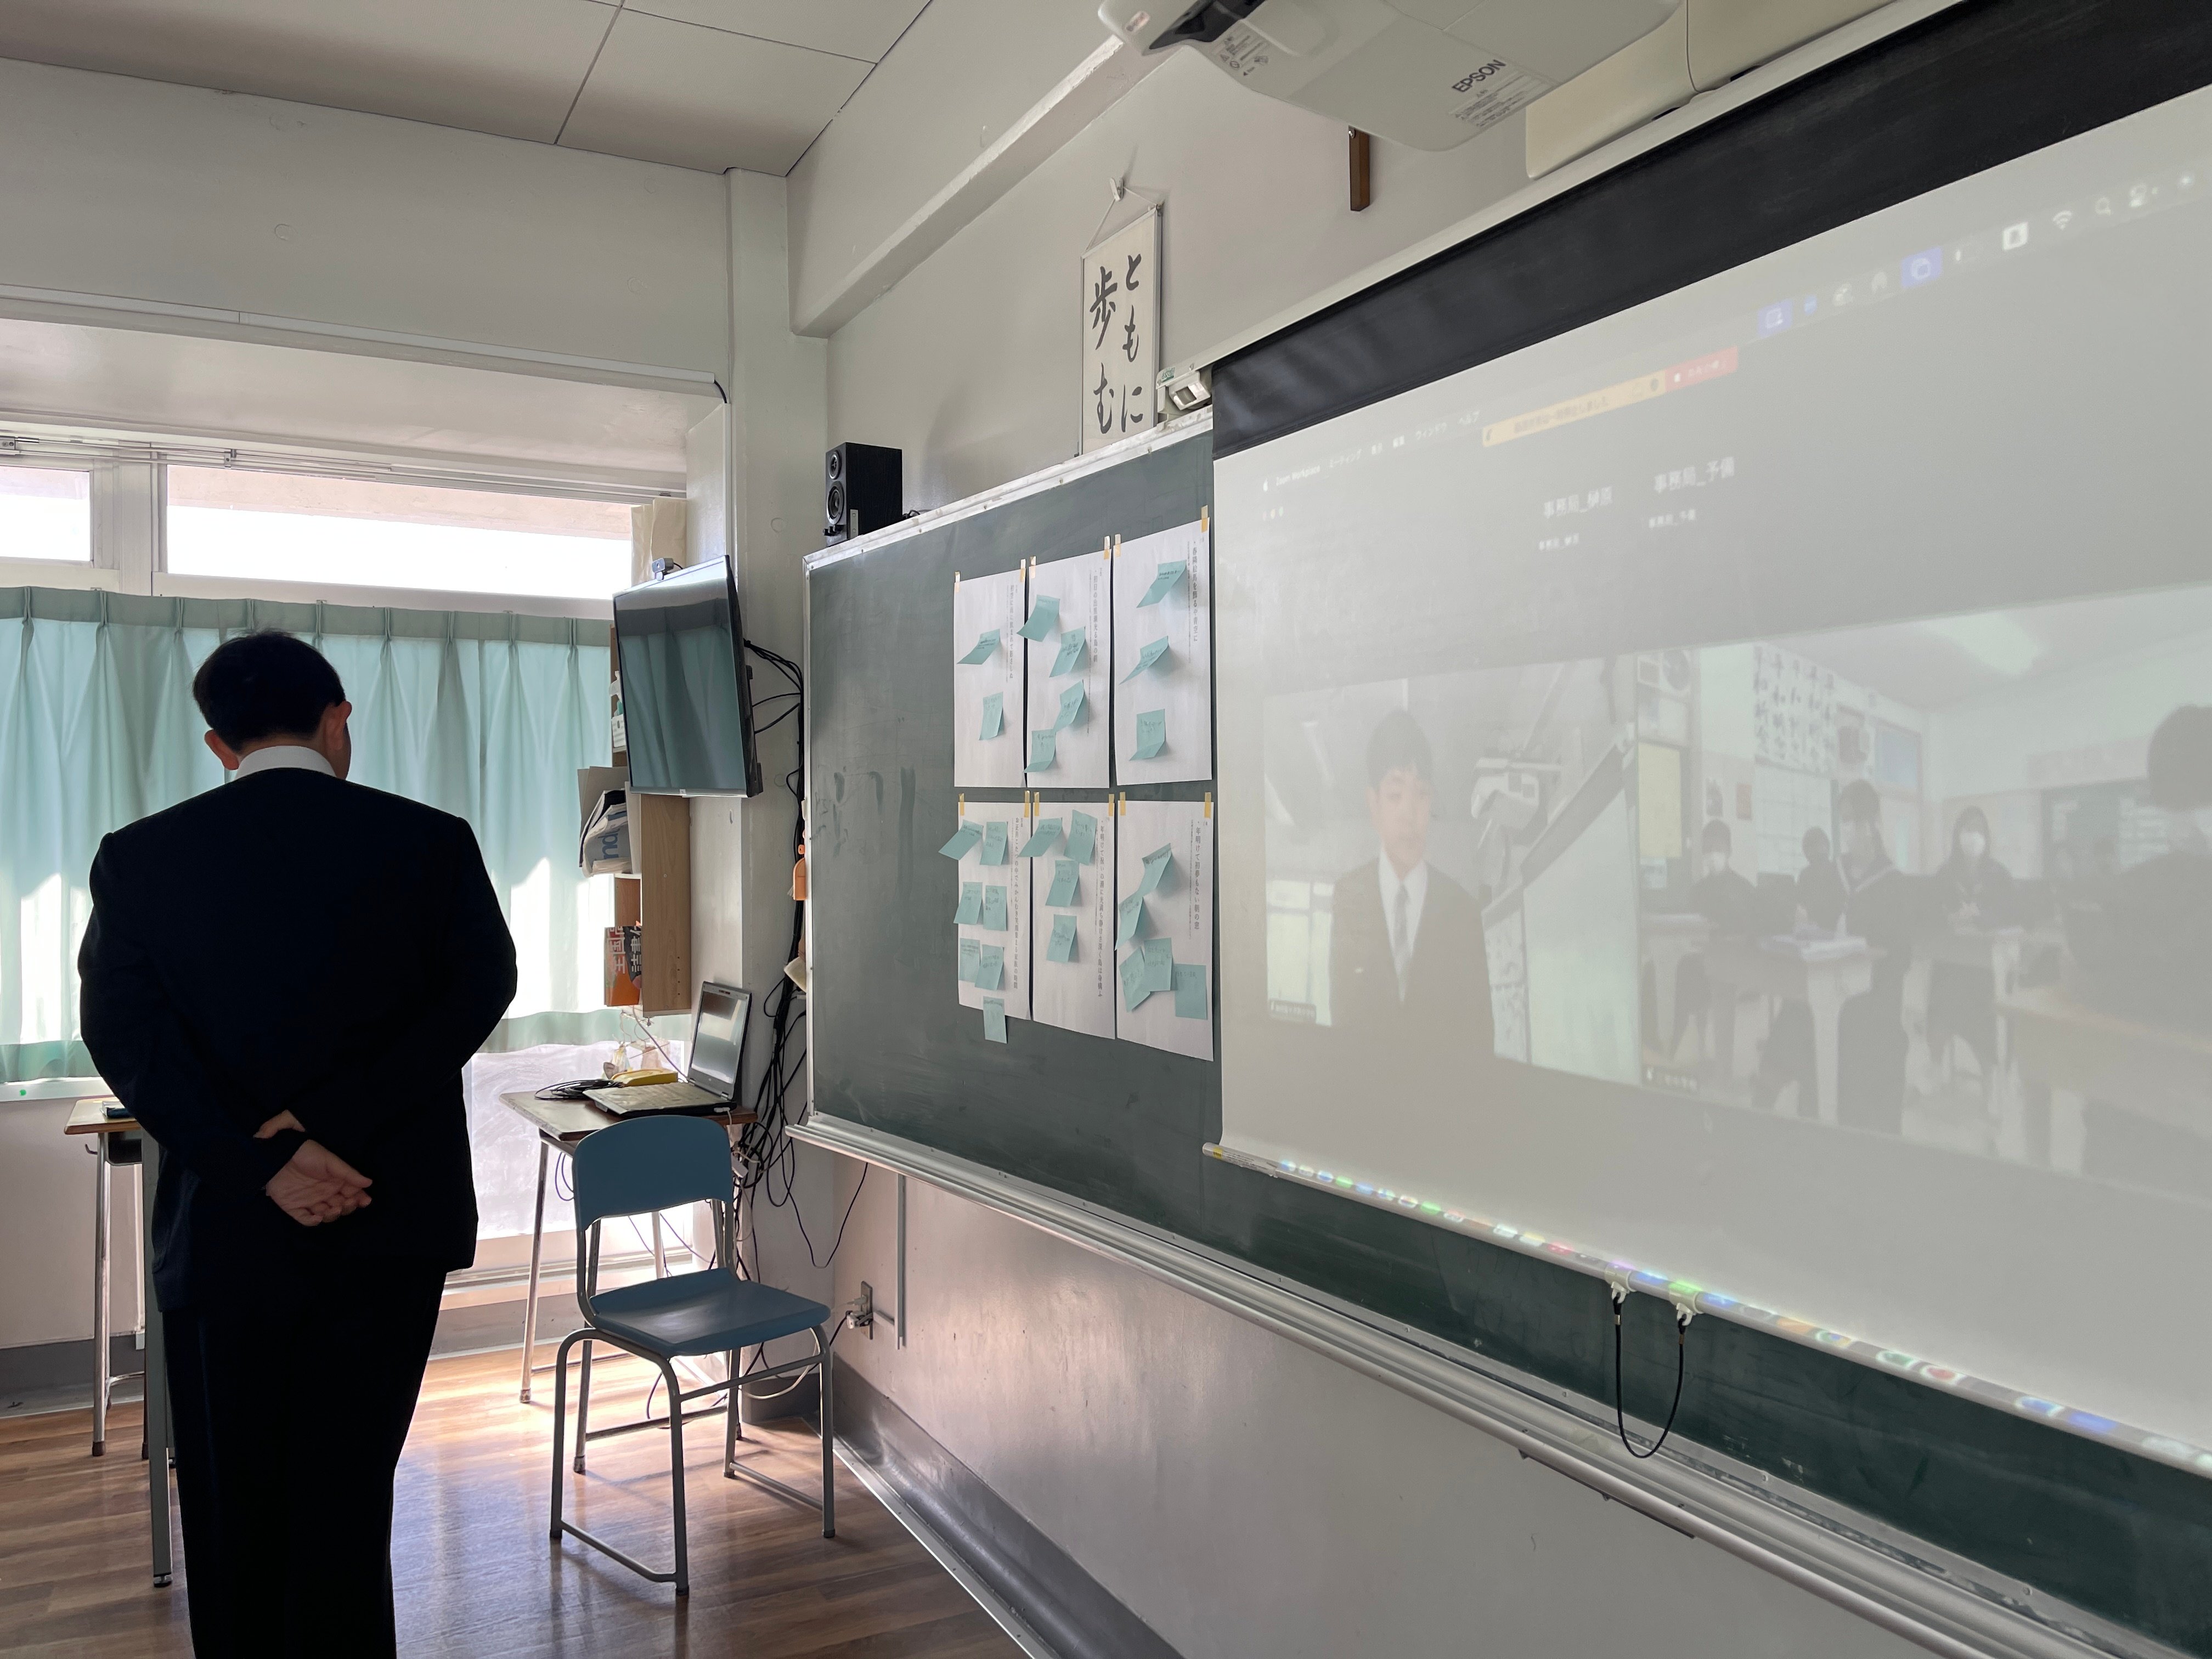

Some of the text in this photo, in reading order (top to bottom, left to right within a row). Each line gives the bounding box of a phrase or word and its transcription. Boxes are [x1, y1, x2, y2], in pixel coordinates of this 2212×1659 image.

[1451, 59, 1507, 93] EPSON
[1090, 266, 1118, 434] 歩む
[1121, 253, 1144, 433] ともに
